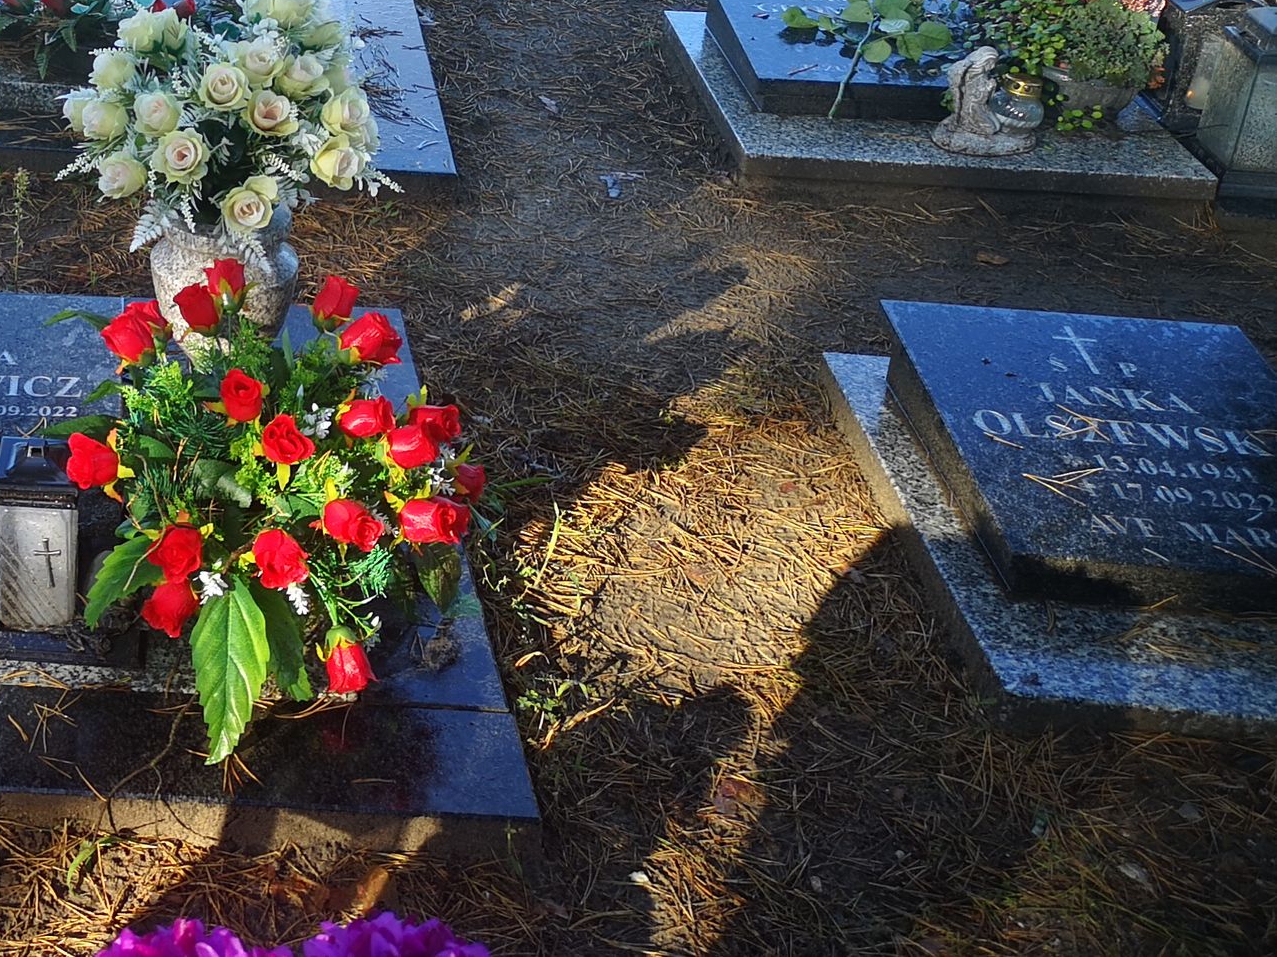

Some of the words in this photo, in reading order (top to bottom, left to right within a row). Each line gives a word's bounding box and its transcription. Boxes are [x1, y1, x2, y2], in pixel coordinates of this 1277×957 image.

[1118, 361, 1138, 378] P
[1030, 382, 1200, 414] JANKA
[973, 409, 1274, 456] OLSZEWSK
[1089, 513, 1164, 539] AVE
